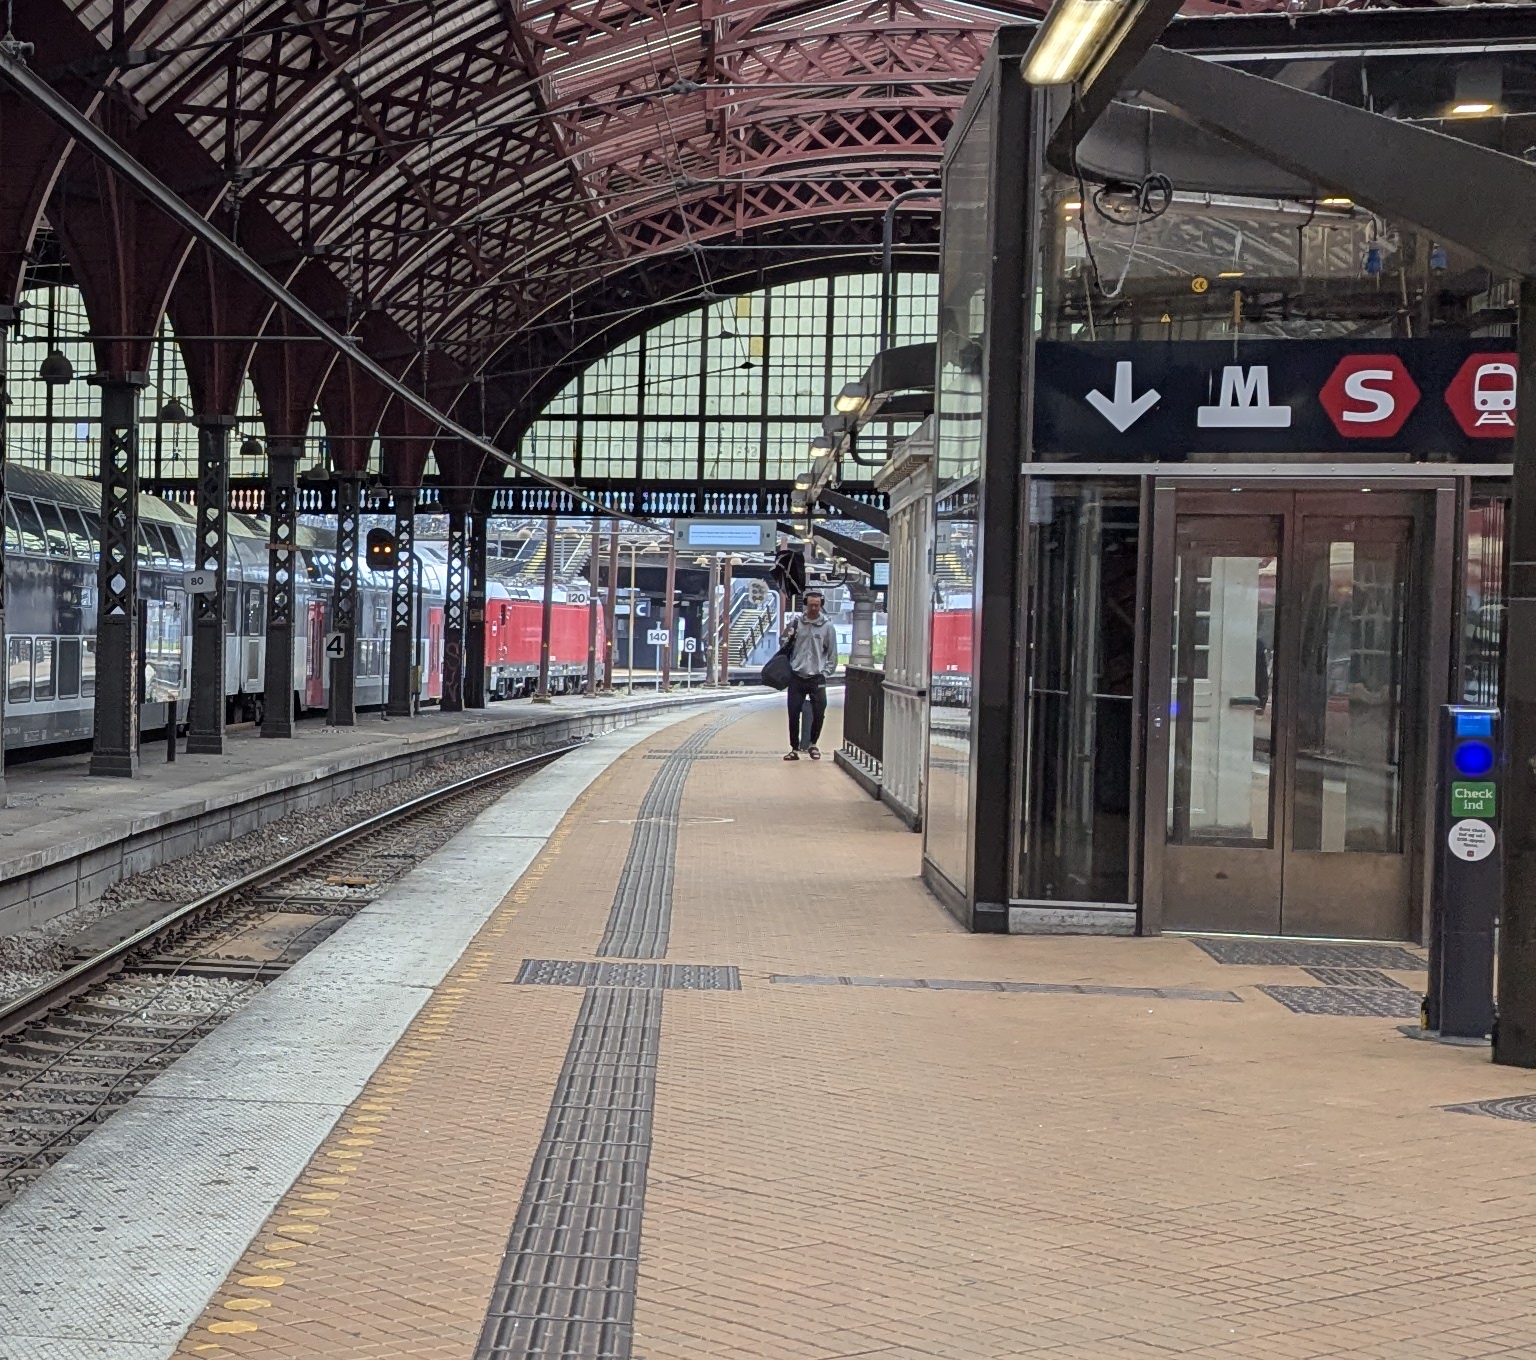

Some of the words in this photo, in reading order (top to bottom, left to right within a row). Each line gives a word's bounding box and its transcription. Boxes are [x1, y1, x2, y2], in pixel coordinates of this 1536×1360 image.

[1343, 370, 1395, 422] S
[190, 577, 203, 585] 80
[568, 593, 585, 603] 120
[649, 632, 667, 642] 140
[327, 635, 343, 655] 4
[686, 639, 695, 651] 6
[1454, 788, 1493, 798] Check
[1464, 800, 1483, 810] ind
